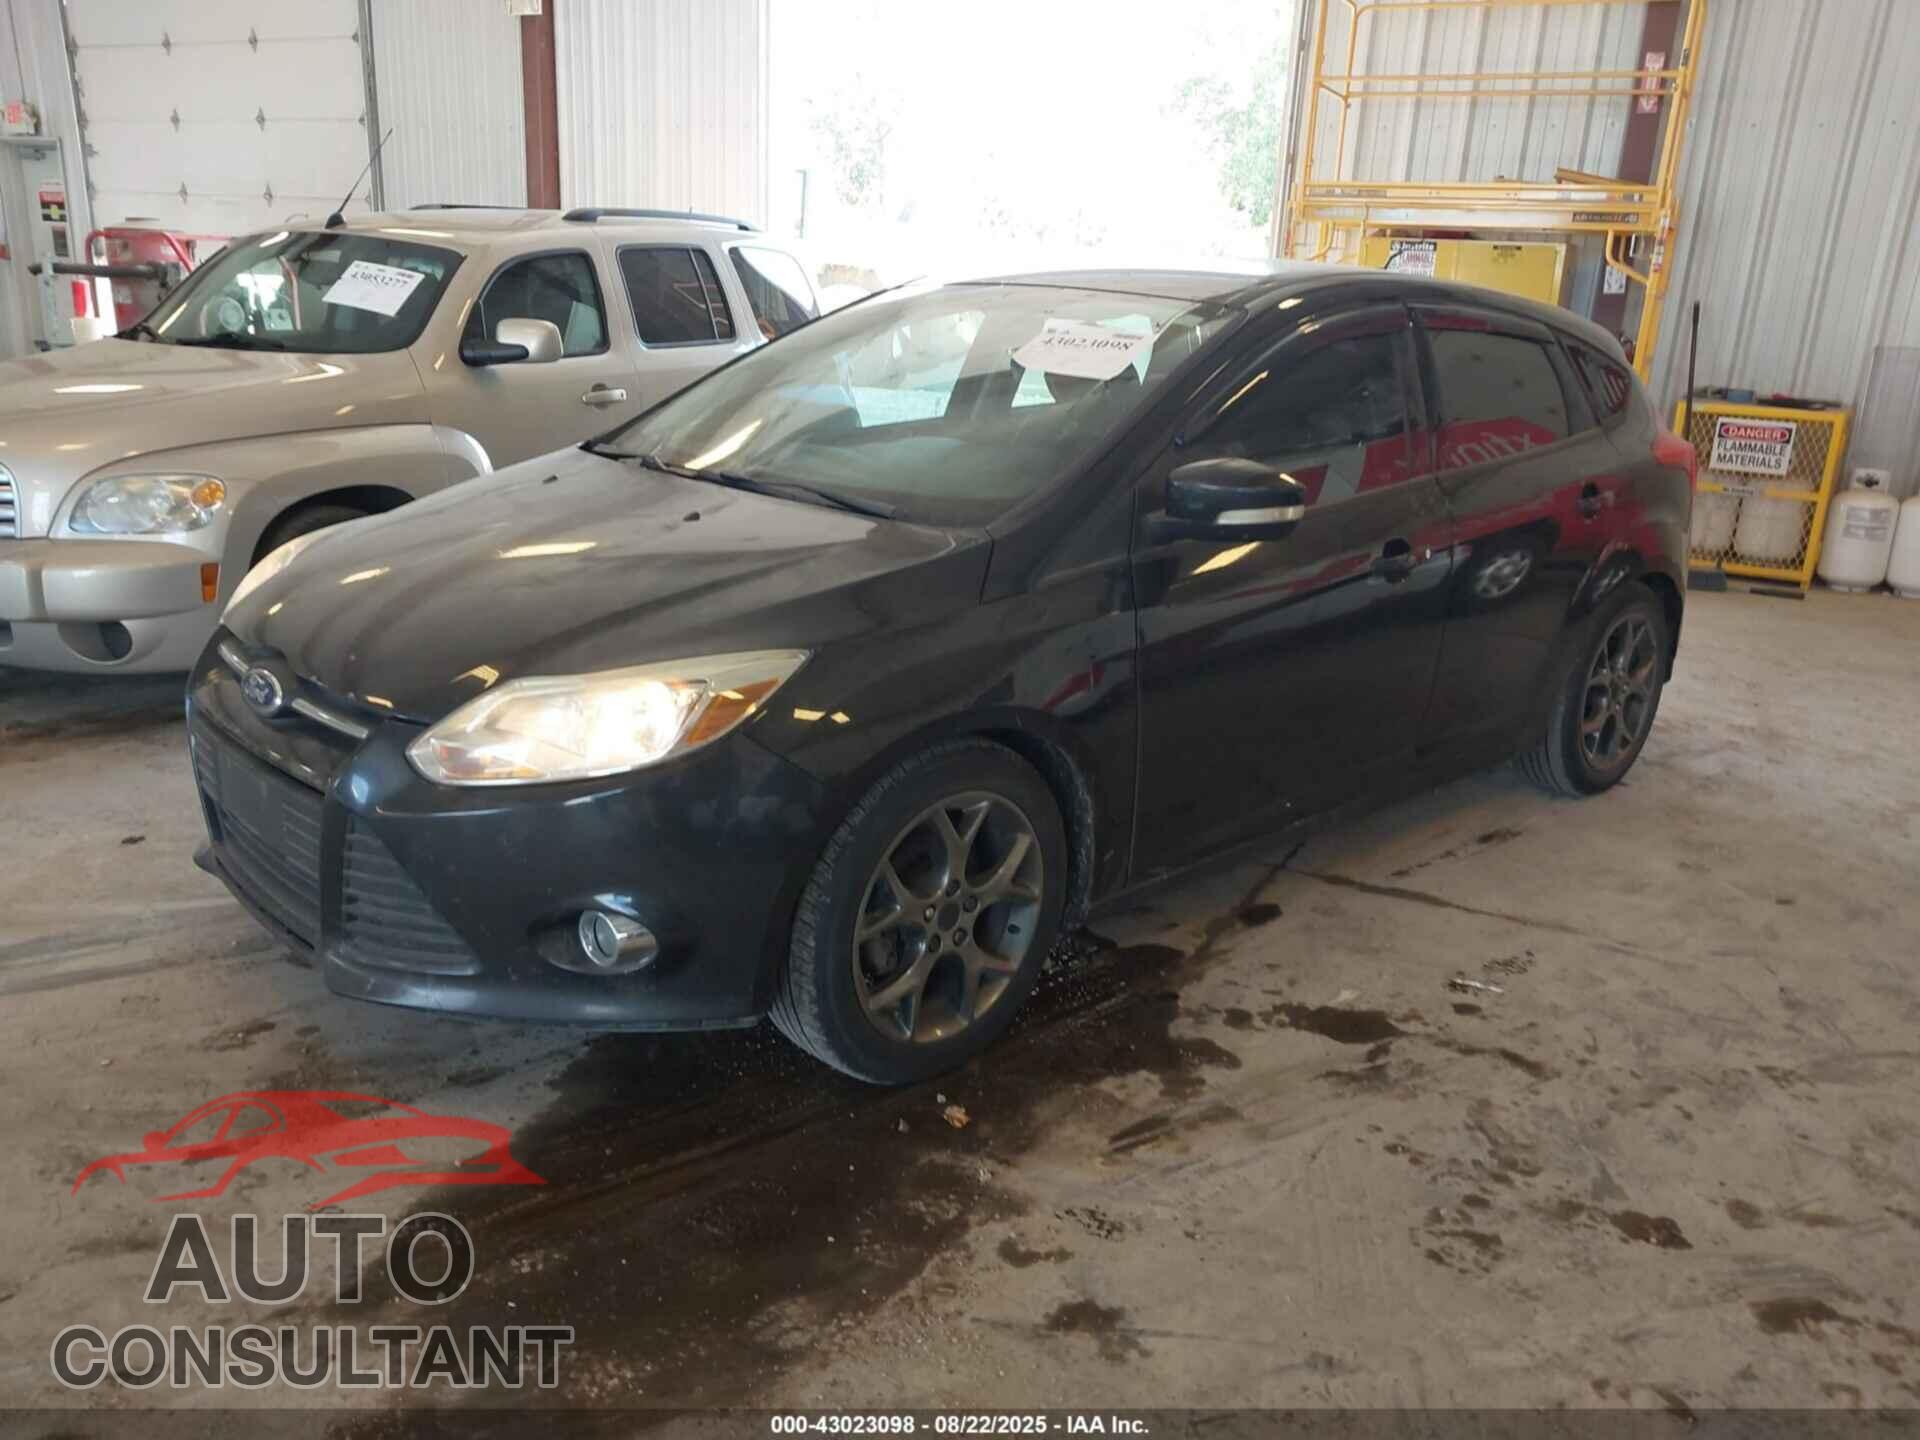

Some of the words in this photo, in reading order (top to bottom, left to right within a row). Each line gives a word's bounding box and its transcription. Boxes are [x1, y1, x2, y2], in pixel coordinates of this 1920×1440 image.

[1728, 427, 1781, 440] DANGER
[1717, 439, 1787, 456] FLAMMABLE
[1716, 452, 1782, 469] MATERIALS
